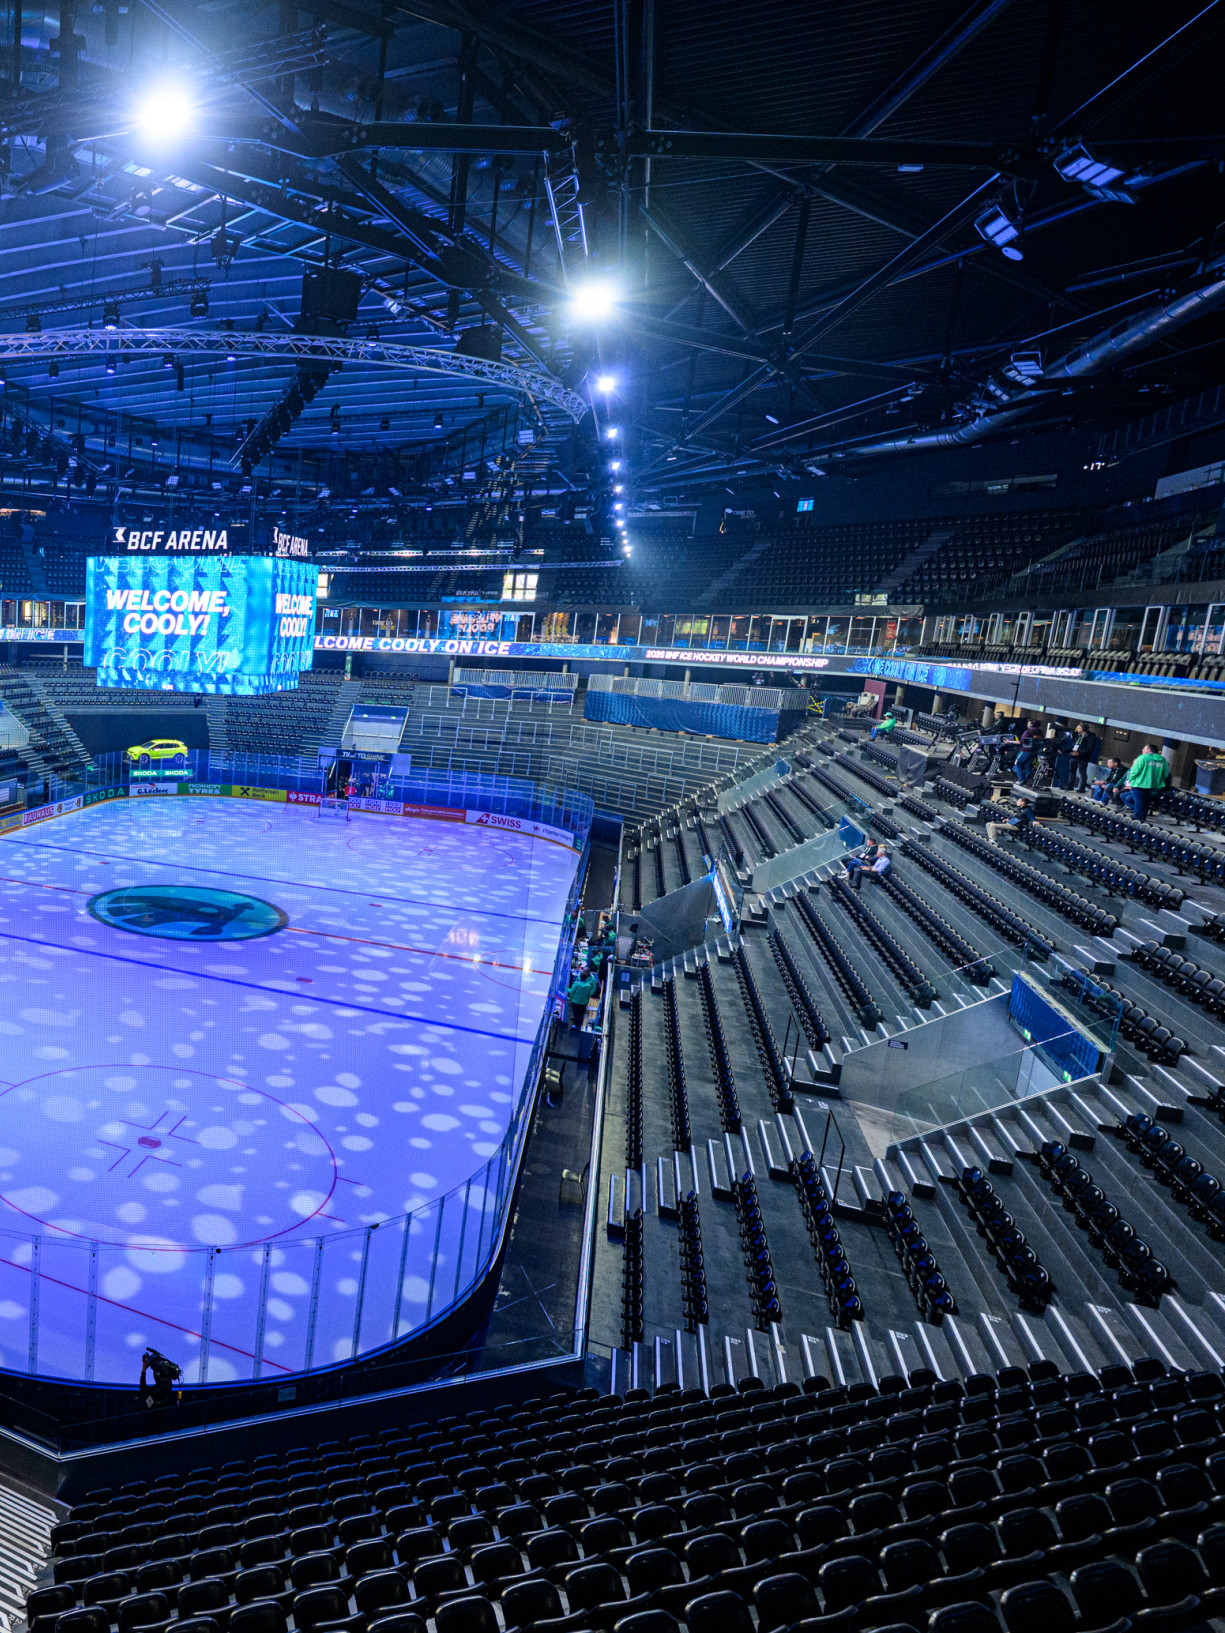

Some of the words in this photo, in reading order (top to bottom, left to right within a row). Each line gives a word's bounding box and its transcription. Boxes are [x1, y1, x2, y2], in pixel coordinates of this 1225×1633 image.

[127, 531, 164, 550] BCF
[165, 530, 228, 550] ARENA
[278, 533, 290, 552] BCF
[291, 537, 308, 557] ARENA
[106, 590, 230, 617] WELCOME,
[276, 593, 313, 619] WELCOME,
[123, 613, 210, 636] COOLY!
[280, 617, 308, 638] COOLY!
[314, 636, 373, 650] LCOME
[378, 638, 440, 652] COOLY
[445, 640, 474, 654] ON
[478, 641, 511, 655] ICE
[646, 650, 665, 659] 2026
[679, 652, 693, 661] ICE
[693, 653, 726, 663] HOCKEY
[726, 655, 757, 665] WORLD
[758, 656, 829, 668] CHAMPIONSHIP
[86, 787, 124, 804] SKODA
[298, 793, 322, 803] STRA
[23, 805, 54, 824] BAUHAUS
[491, 815, 521, 829] SWISS
